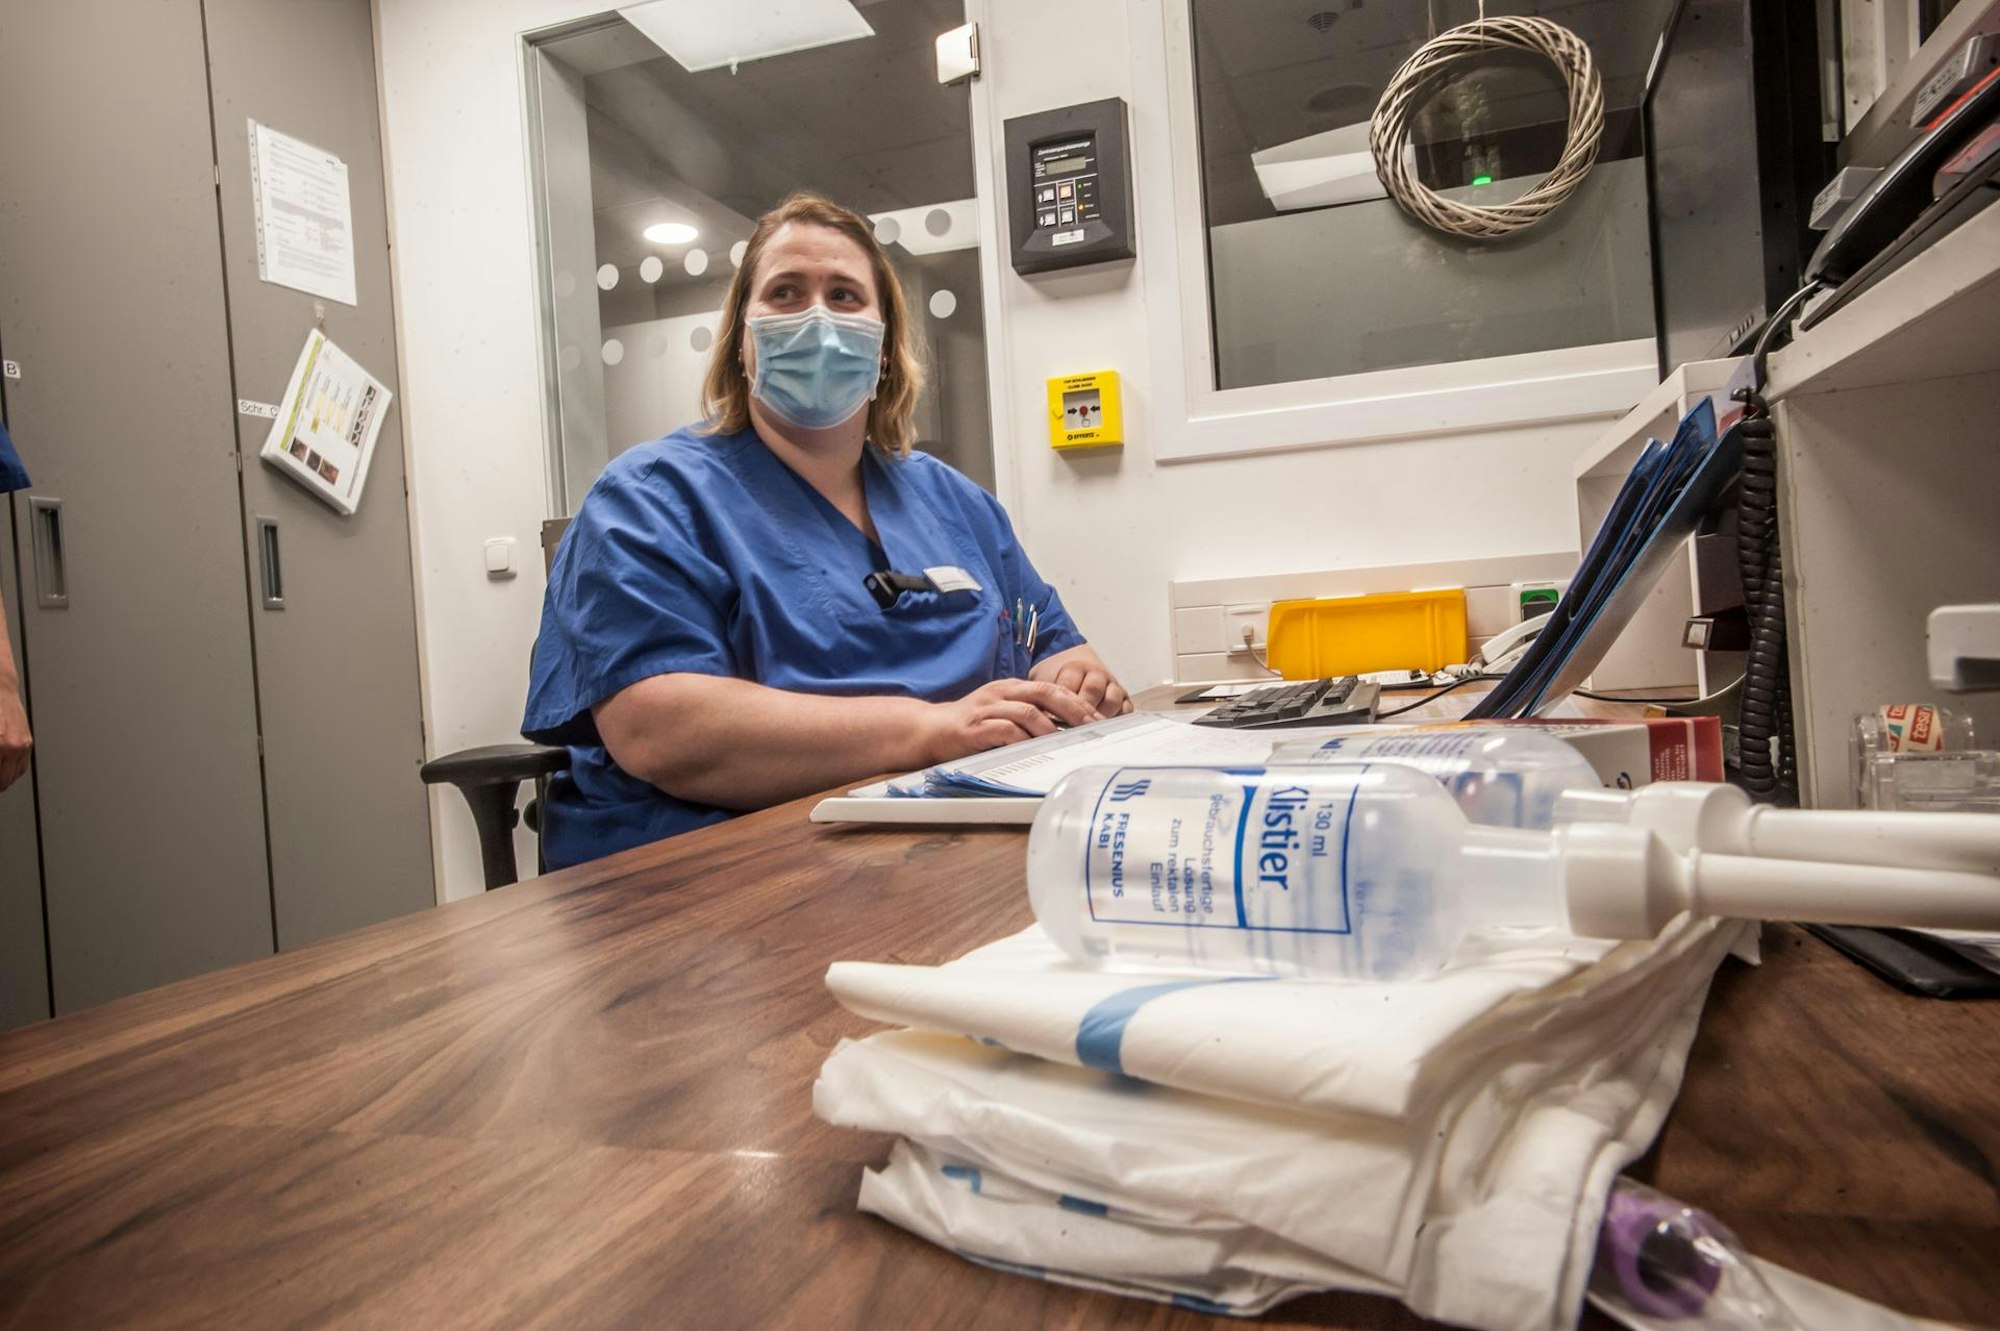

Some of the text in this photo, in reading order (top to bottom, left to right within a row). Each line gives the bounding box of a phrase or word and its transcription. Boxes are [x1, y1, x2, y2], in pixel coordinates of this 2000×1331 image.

[6, 362, 18, 376] B
[1912, 710, 1931, 740] tesa
[1097, 813, 1115, 849] KABI
[1110, 812, 1131, 898] FRESENIUS
[1199, 793, 1224, 915] gebrauchsfertige
[1311, 802, 1334, 857] 130 ml
[1150, 861, 1166, 913] Einlauf
[1167, 818, 1182, 913] zum rektalen
